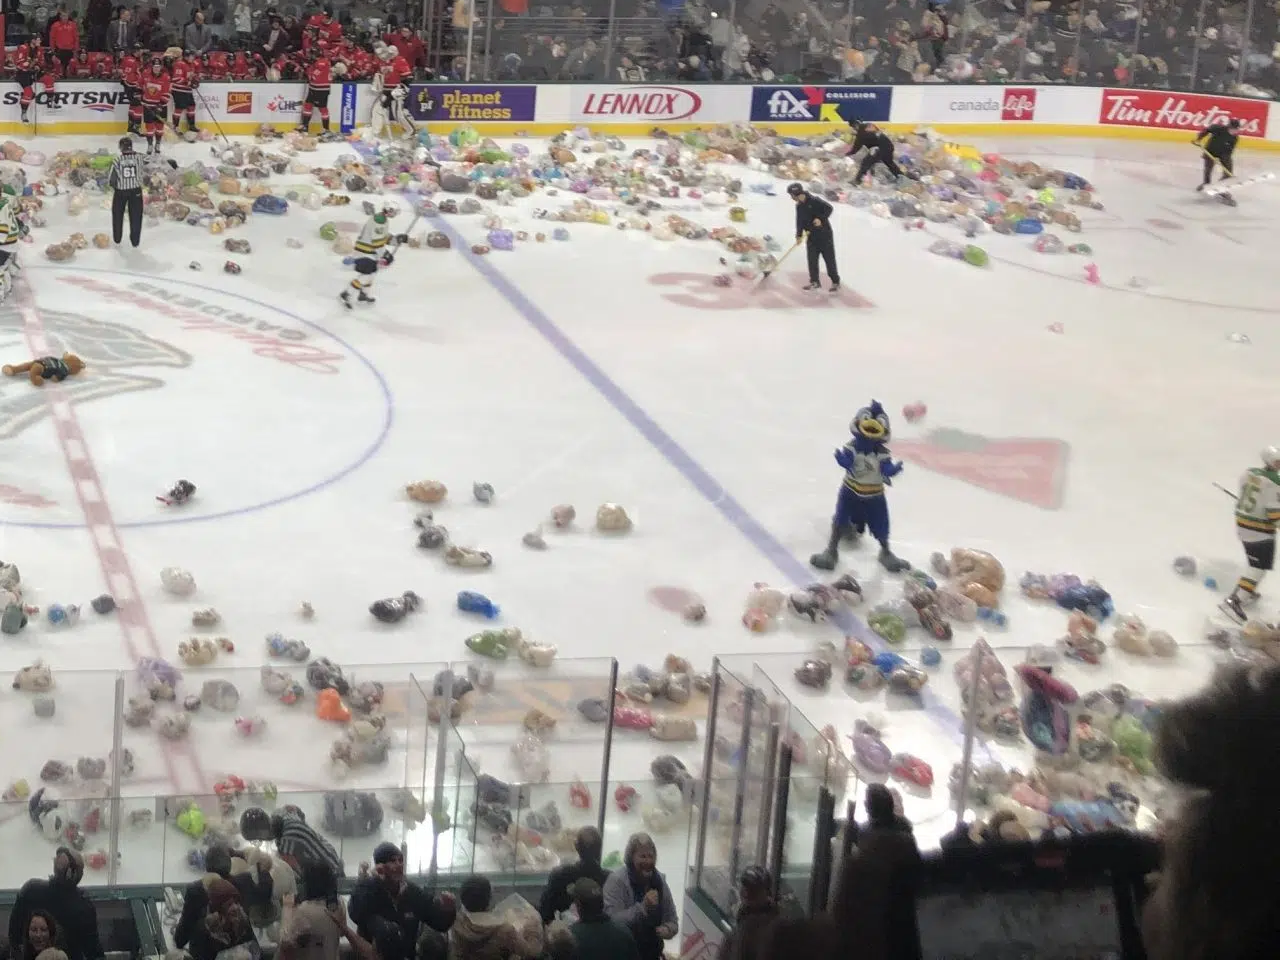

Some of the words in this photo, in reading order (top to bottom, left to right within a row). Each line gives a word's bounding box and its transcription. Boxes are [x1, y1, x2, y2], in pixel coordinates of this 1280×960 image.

[229, 93, 251, 102] CIBC
[442, 90, 502, 107] planet
[583, 92, 680, 115] LENNOX
[767, 90, 813, 117] fix
[950, 97, 1000, 112] canada
[1002, 95, 1037, 117] life
[450, 104, 512, 120] fitness
[1106, 95, 1152, 123] Tim
[123, 167, 136, 177] 61
[128, 283, 308, 341] GARDENS
